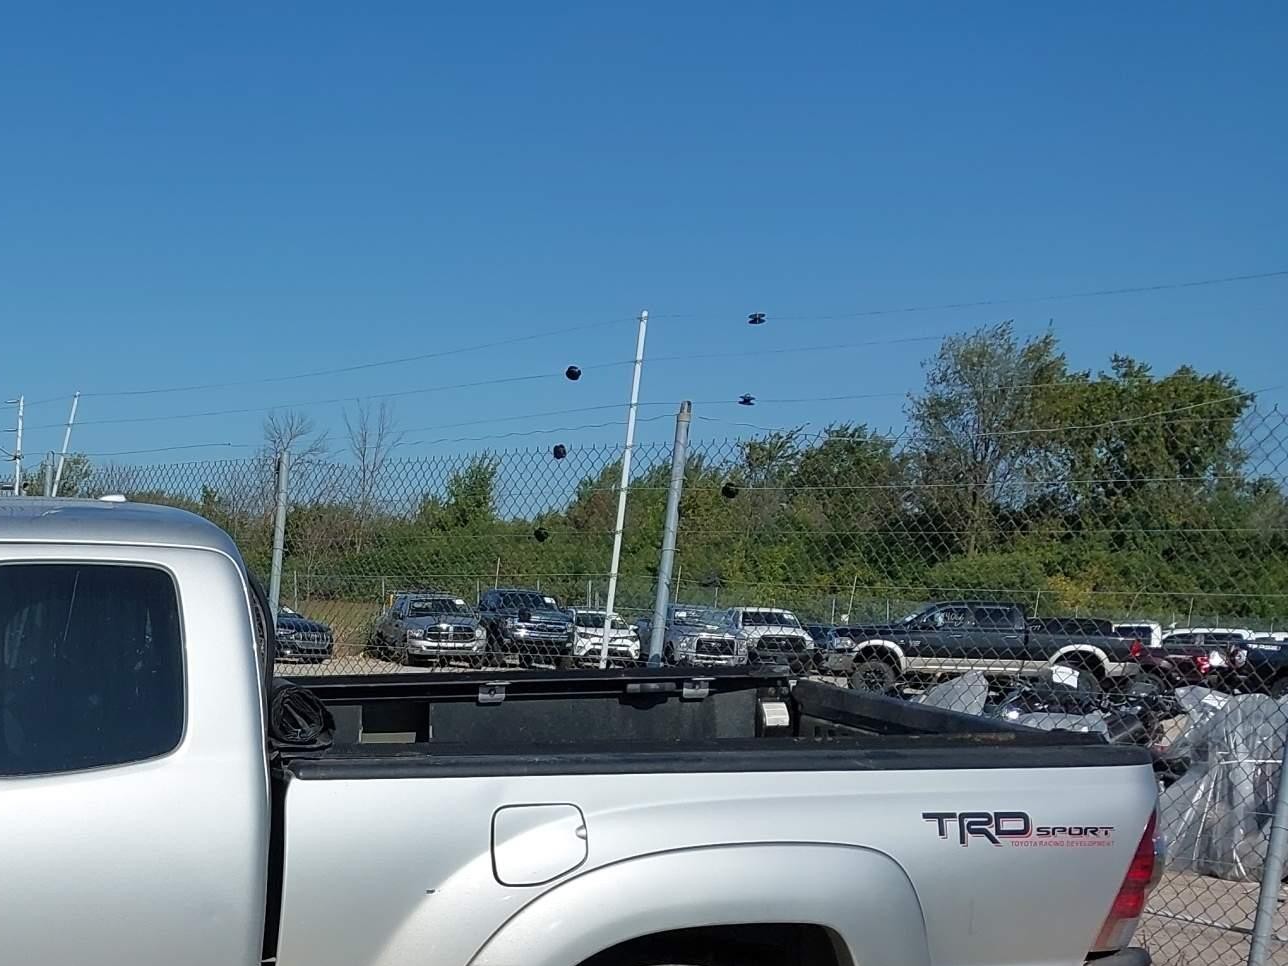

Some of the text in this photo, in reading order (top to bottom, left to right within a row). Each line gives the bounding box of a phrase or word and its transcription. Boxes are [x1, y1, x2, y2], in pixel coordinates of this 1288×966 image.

[921, 811, 1116, 848] TRD SPORT
[1011, 840, 1037, 848] TOYOTA
[1038, 840, 1065, 848] RACING
